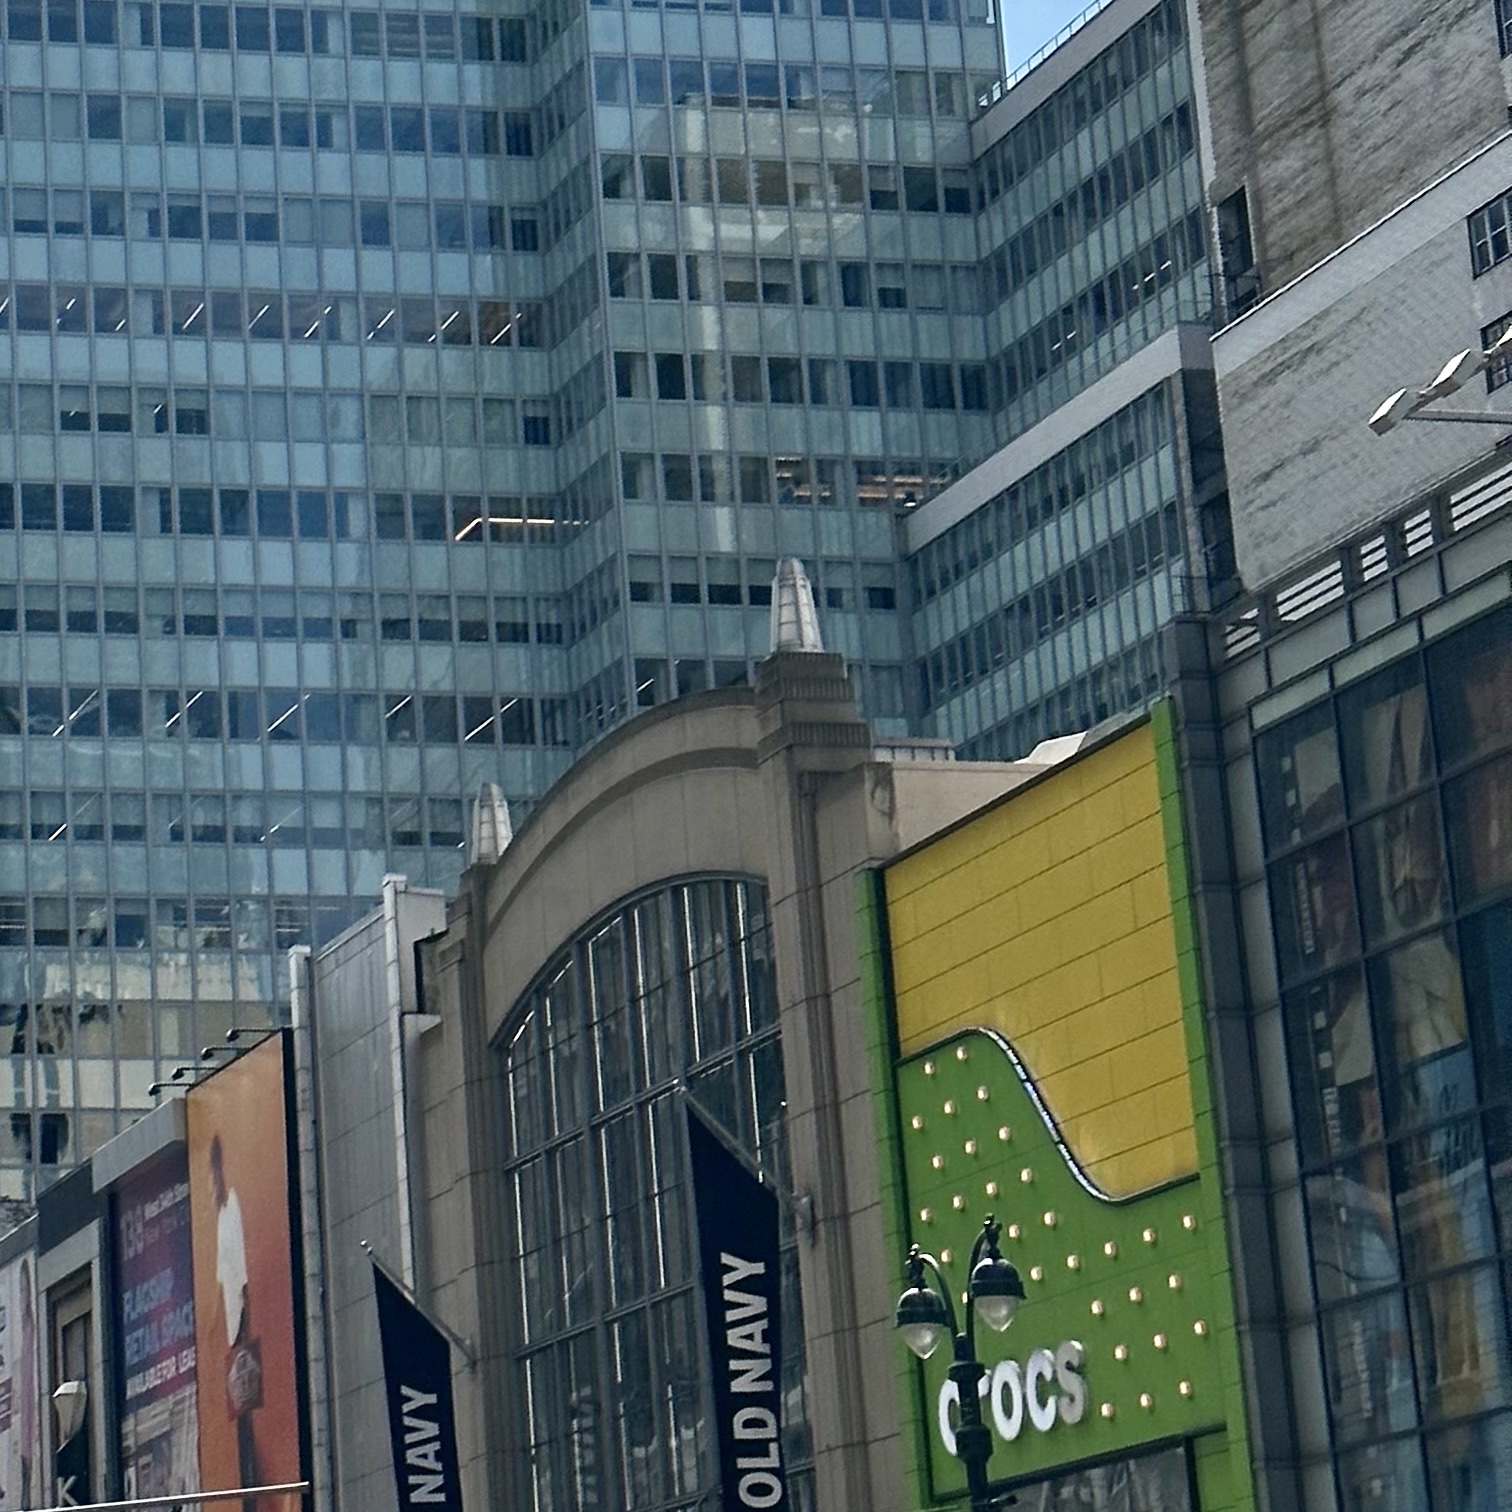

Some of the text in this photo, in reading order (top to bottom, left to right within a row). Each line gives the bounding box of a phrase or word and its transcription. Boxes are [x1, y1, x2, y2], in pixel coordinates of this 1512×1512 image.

[720, 1252, 783, 1508] OLD NAVY
[939, 1340, 1085, 1456] cocs
[400, 1384, 446, 1503] NAVY
